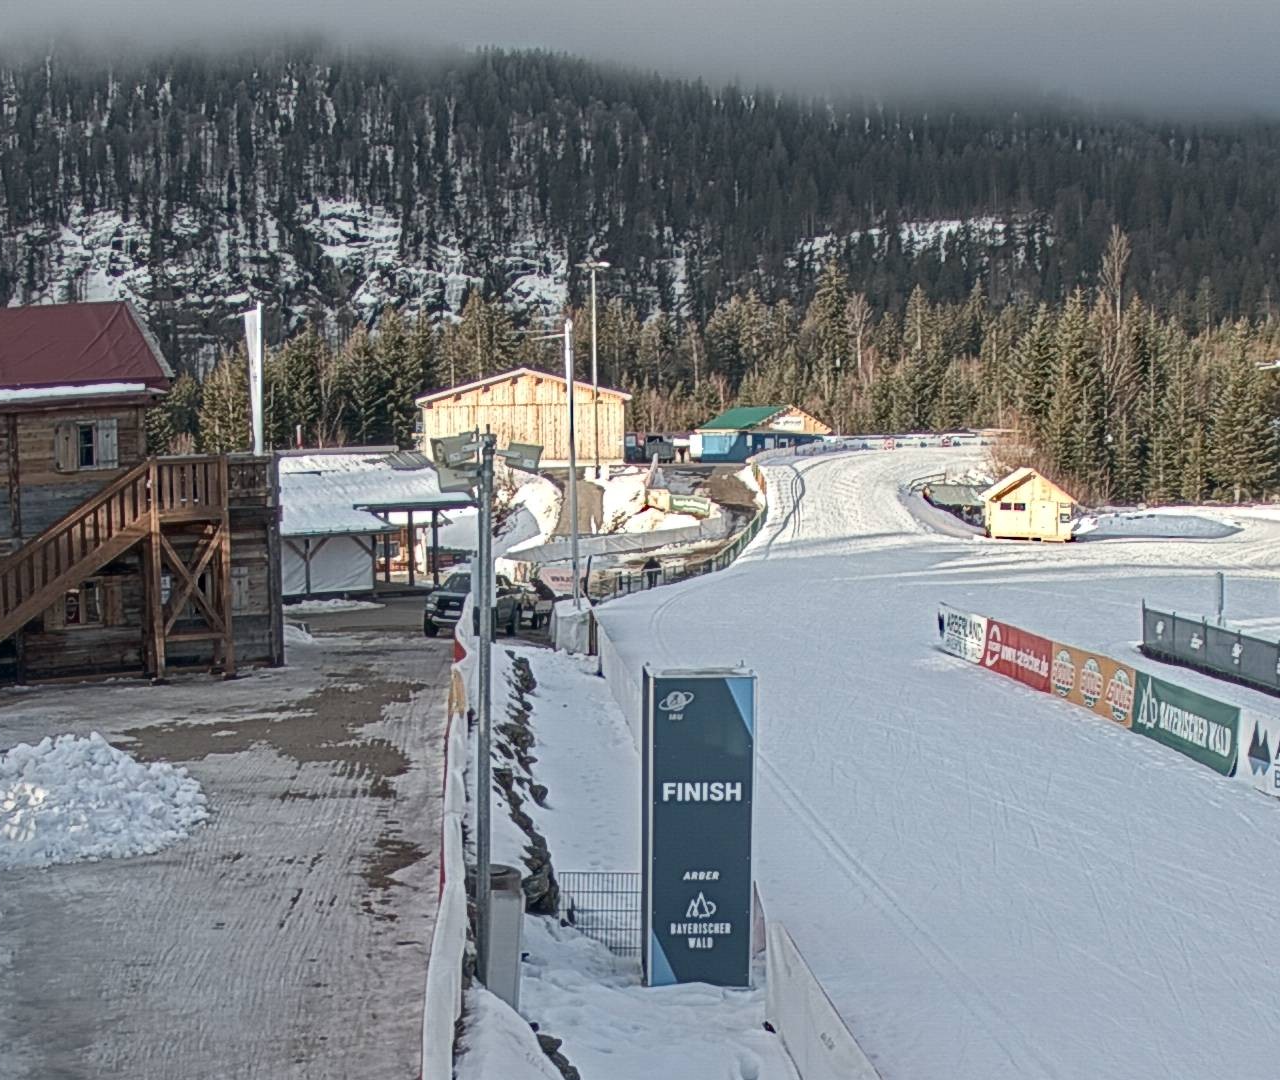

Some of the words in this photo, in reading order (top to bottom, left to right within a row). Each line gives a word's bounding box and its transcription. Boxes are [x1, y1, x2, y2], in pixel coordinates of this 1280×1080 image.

[1159, 702, 1207, 747] BAYERISCHER
[1207, 721, 1232, 757] WALD
[662, 782, 742, 802] FINISH
[670, 922, 731, 935] BAYERISCHER
[688, 937, 714, 948] WALD
